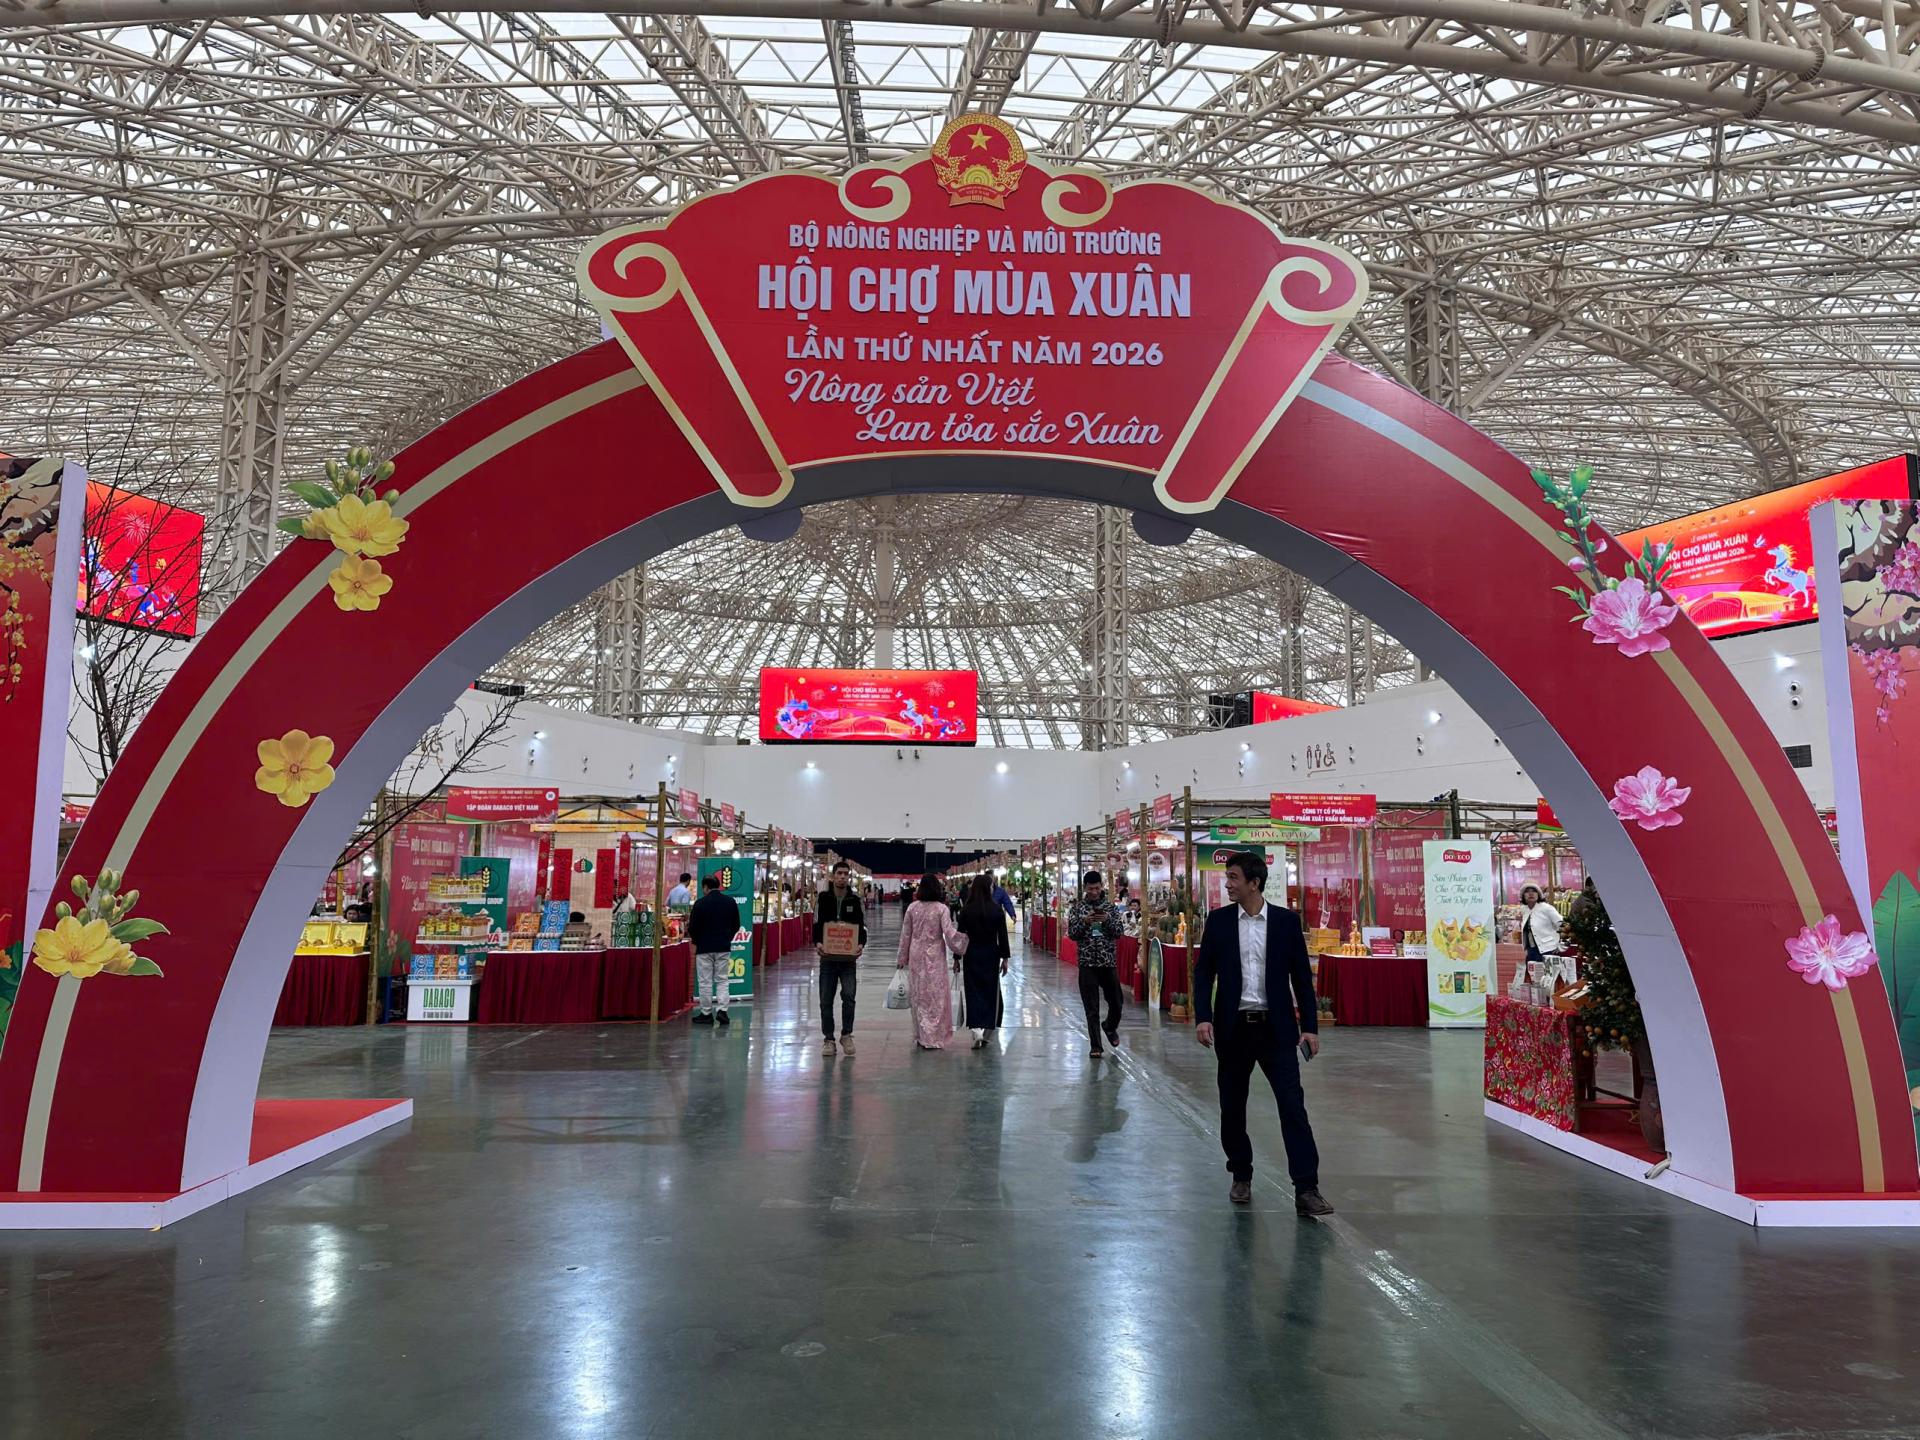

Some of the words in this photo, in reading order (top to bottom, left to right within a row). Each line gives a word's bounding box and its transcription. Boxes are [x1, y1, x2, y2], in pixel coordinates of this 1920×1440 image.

[789, 220, 819, 253] BỘ
[827, 221, 890, 250] NÔNG
[897, 224, 980, 257] NGHIỆP
[987, 225, 1016, 253] VÀ
[1023, 226, 1066, 254] MÔI
[1073, 227, 1161, 255] TRƯỜNG
[758, 255, 832, 320] HỘI
[849, 264, 940, 324] CHỢ
[954, 261, 1055, 316] MÙA
[1068, 263, 1191, 318] XUÂN
[786, 324, 844, 361] LẦN
[854, 331, 914, 362] THỨ
[921, 329, 1003, 364] NHẤT
[1012, 336, 1081, 366] NĂM
[1091, 342, 1164, 367] 2026
[784, 368, 886, 415] Nông
[892, 376, 952, 406] sản
[957, 372, 1036, 413] Việt
[855, 408, 936, 443] Lan
[941, 412, 999, 443] tỏa
[1003, 409, 1061, 444] sắc
[1065, 411, 1164, 445] Xuân
[727, 958, 745, 977] 26
